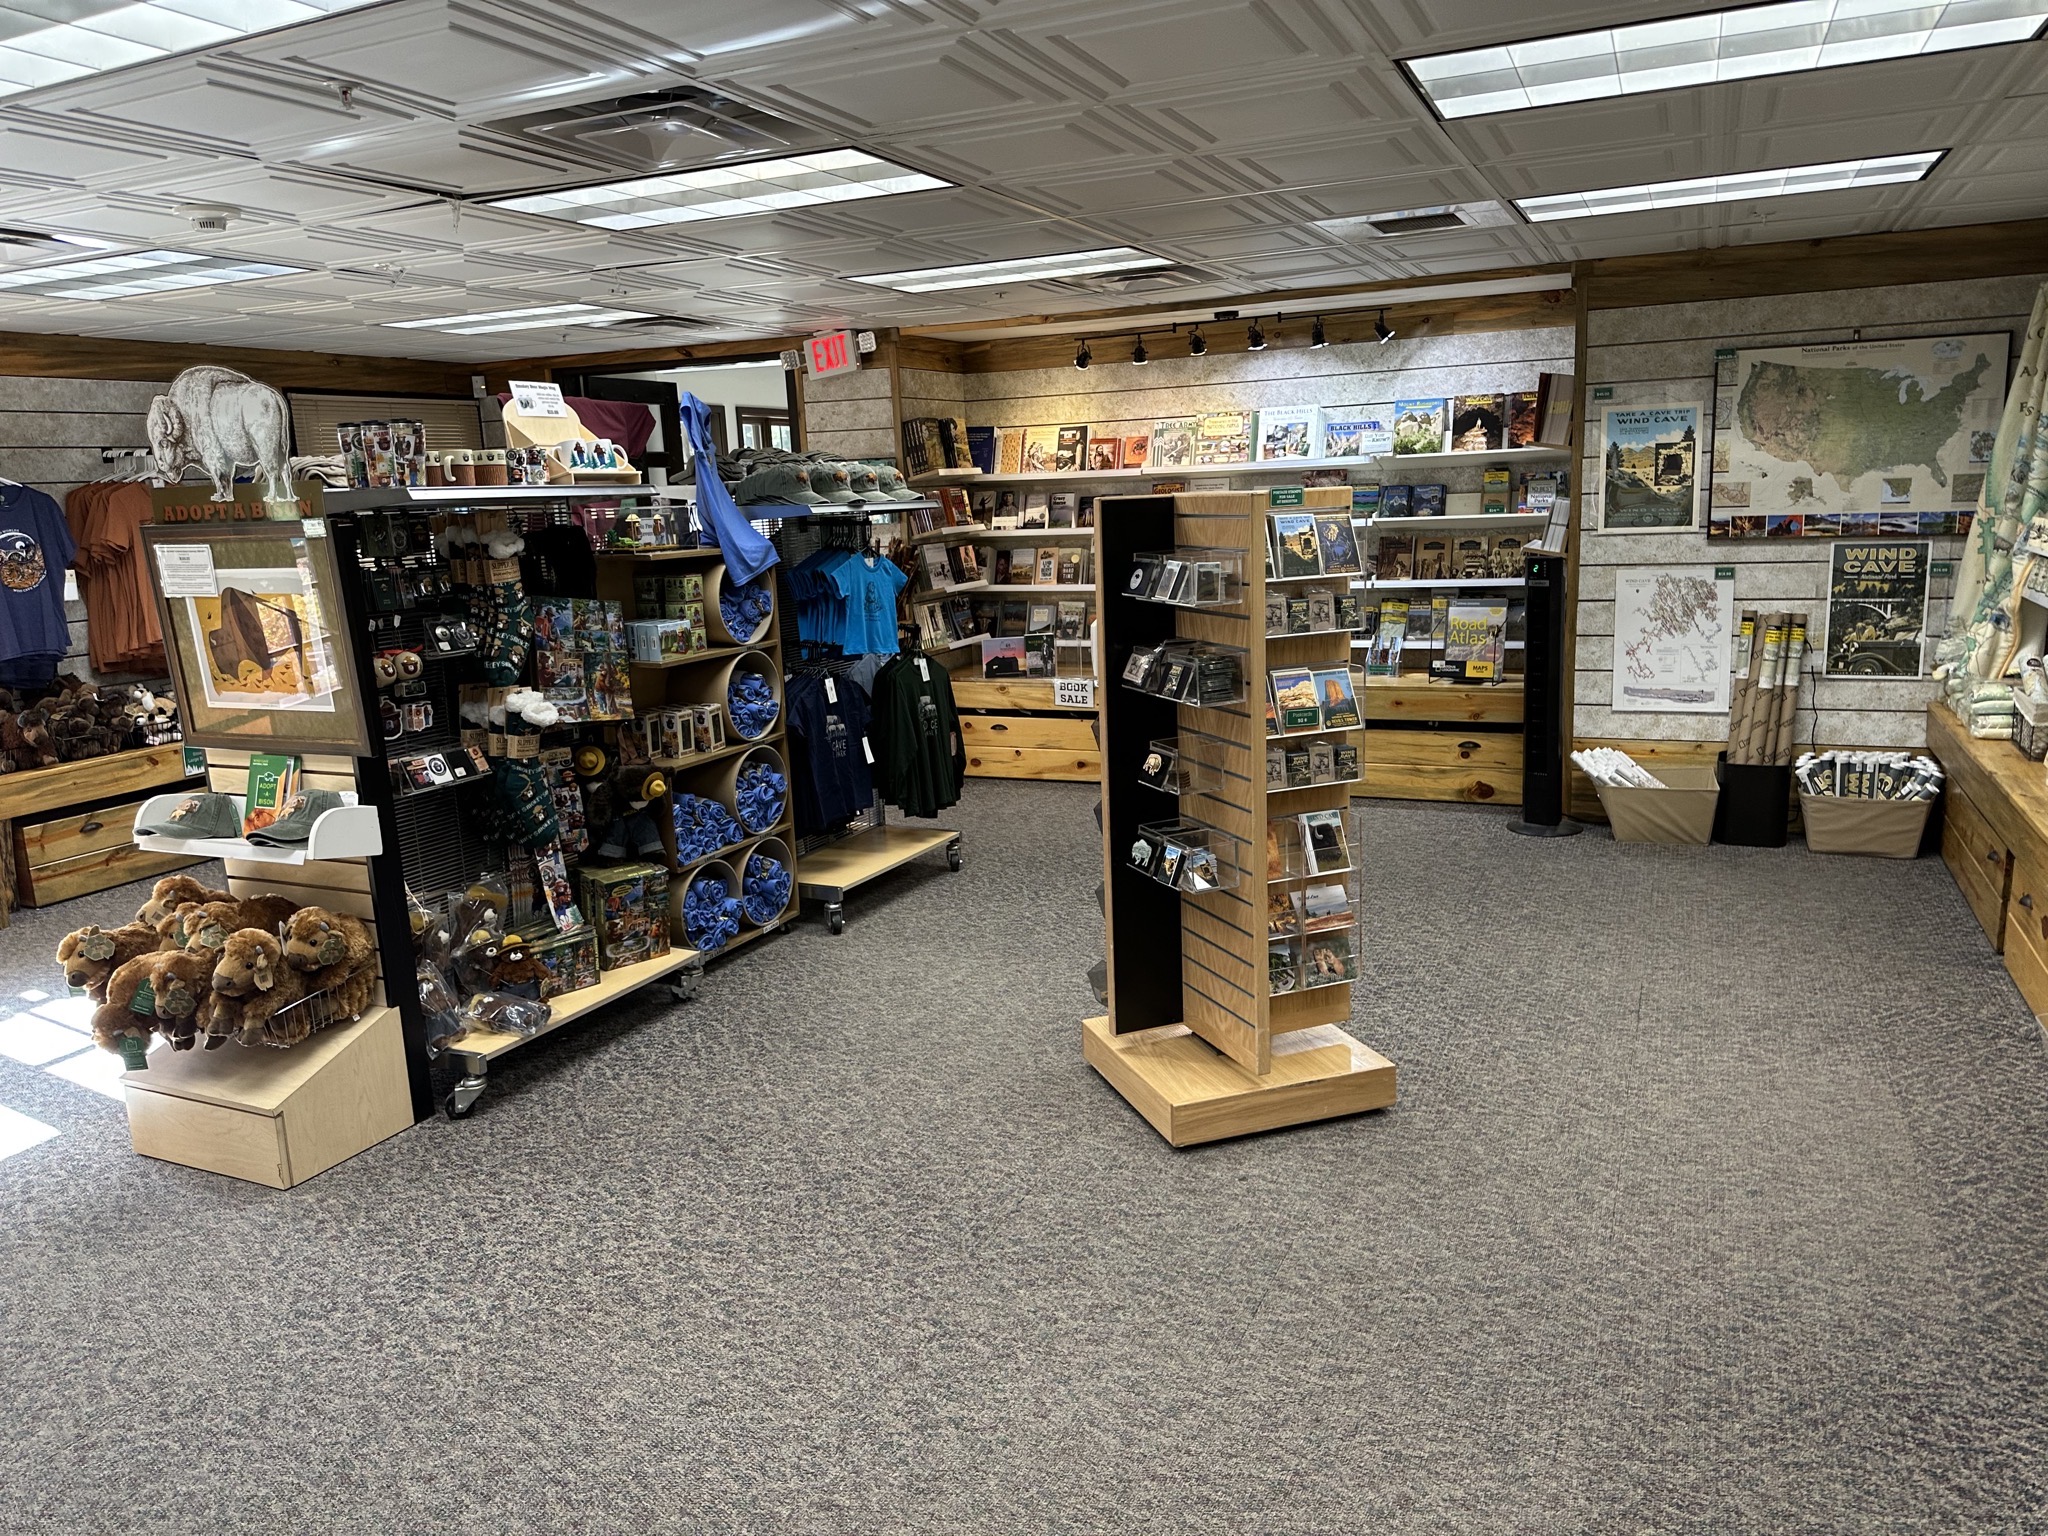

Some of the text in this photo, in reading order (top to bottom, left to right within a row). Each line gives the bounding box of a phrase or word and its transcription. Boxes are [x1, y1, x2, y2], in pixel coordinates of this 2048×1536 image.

[811, 333, 849, 373] EXIT
[1801, 346, 1830, 354] National
[1832, 344, 1851, 352] Parks
[1617, 415, 1688, 425] WIND CAVE
[1352, 423, 1372, 431] HILLS
[1154, 486, 1185, 494] GEOLOGIST
[164, 500, 313, 521] ADOPT A BISON
[1845, 547, 1917, 560] WIND
[1843, 560, 1916, 573] CAVE
[1450, 616, 1488, 631] Road
[1449, 630, 1486, 646] Atlas
[1059, 682, 1089, 693] BOOK
[1060, 694, 1088, 705] SALE
[832, 739, 847, 751] CAVE
[259, 782, 277, 790] ADOPT
